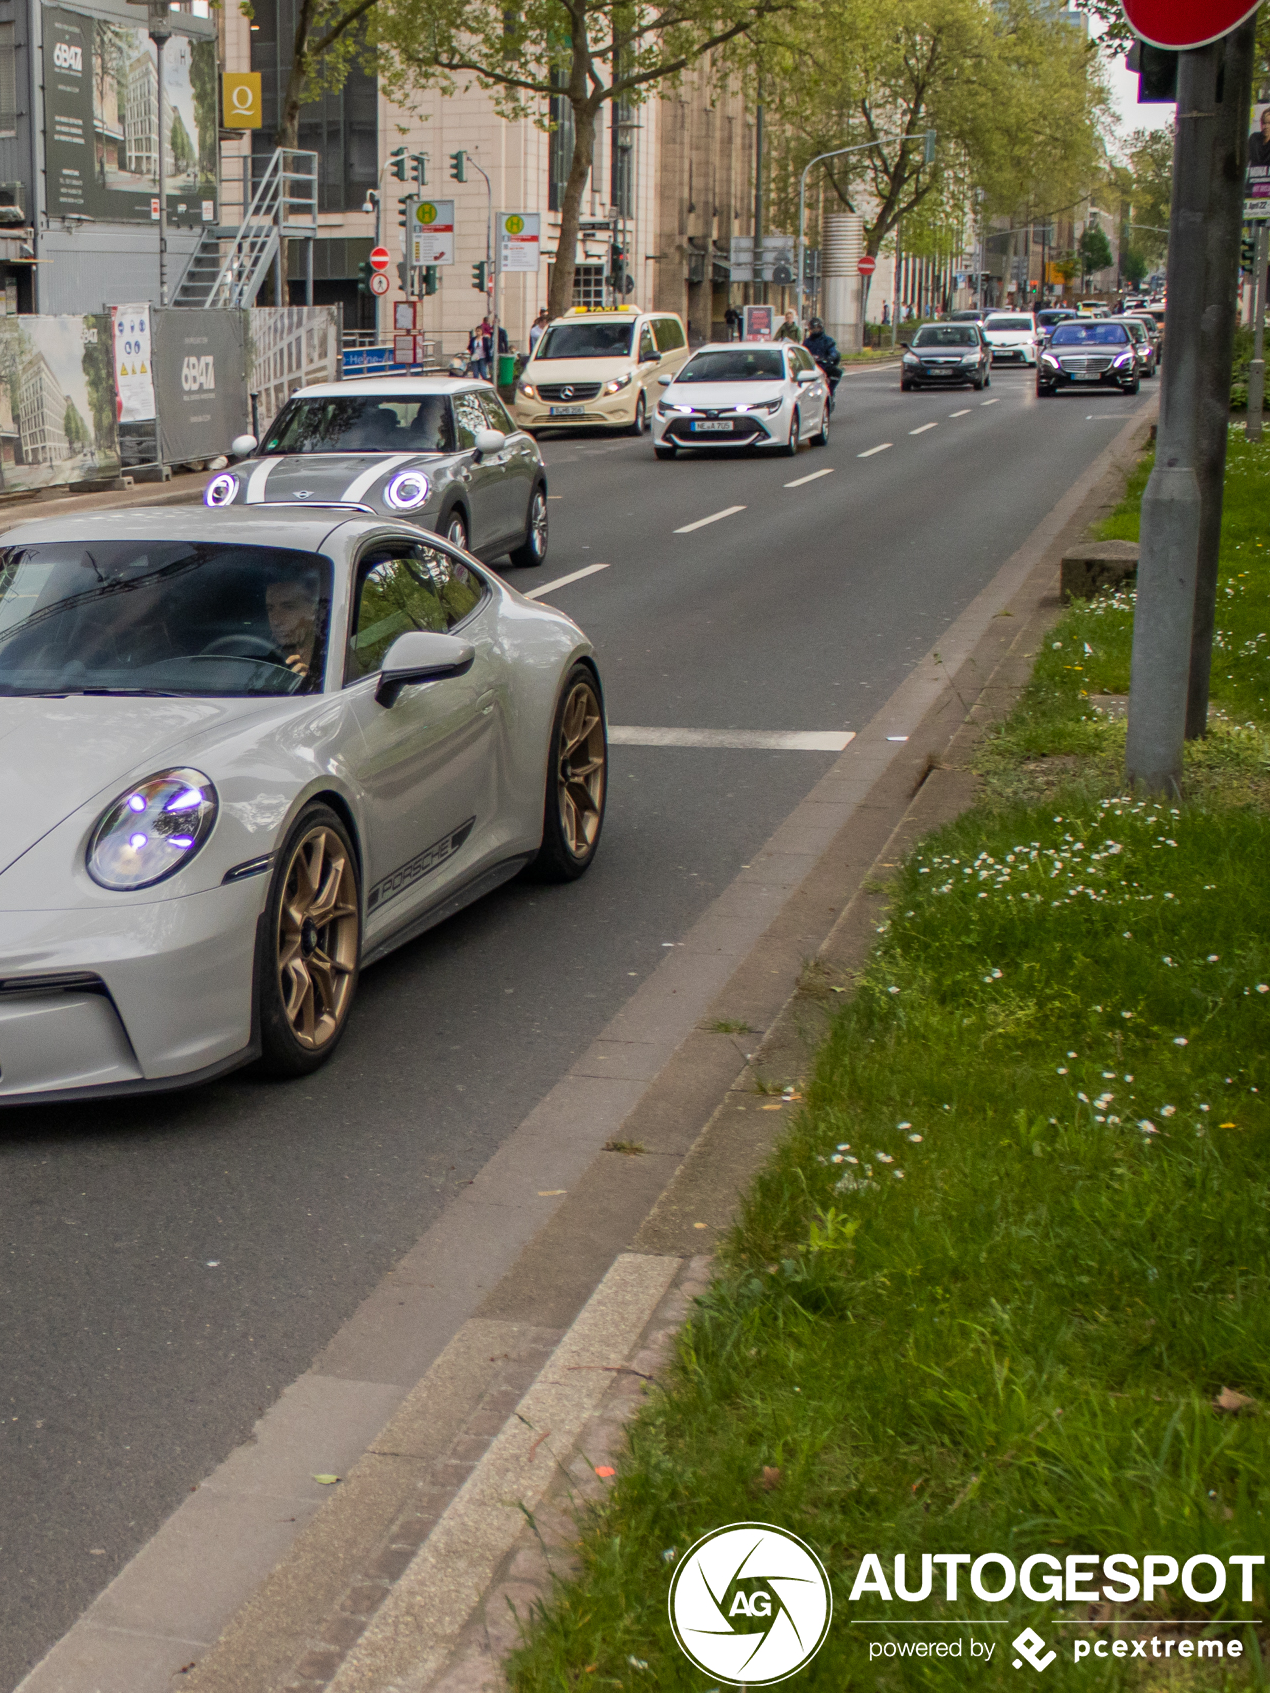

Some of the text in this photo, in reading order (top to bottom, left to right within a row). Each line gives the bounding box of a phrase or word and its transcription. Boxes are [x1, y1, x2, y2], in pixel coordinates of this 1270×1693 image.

[53, 42, 83, 72] 6B47
[231, 85, 256, 116] Q
[181, 355, 216, 391] 6B47
[381, 838, 451, 900] PORSCHE
